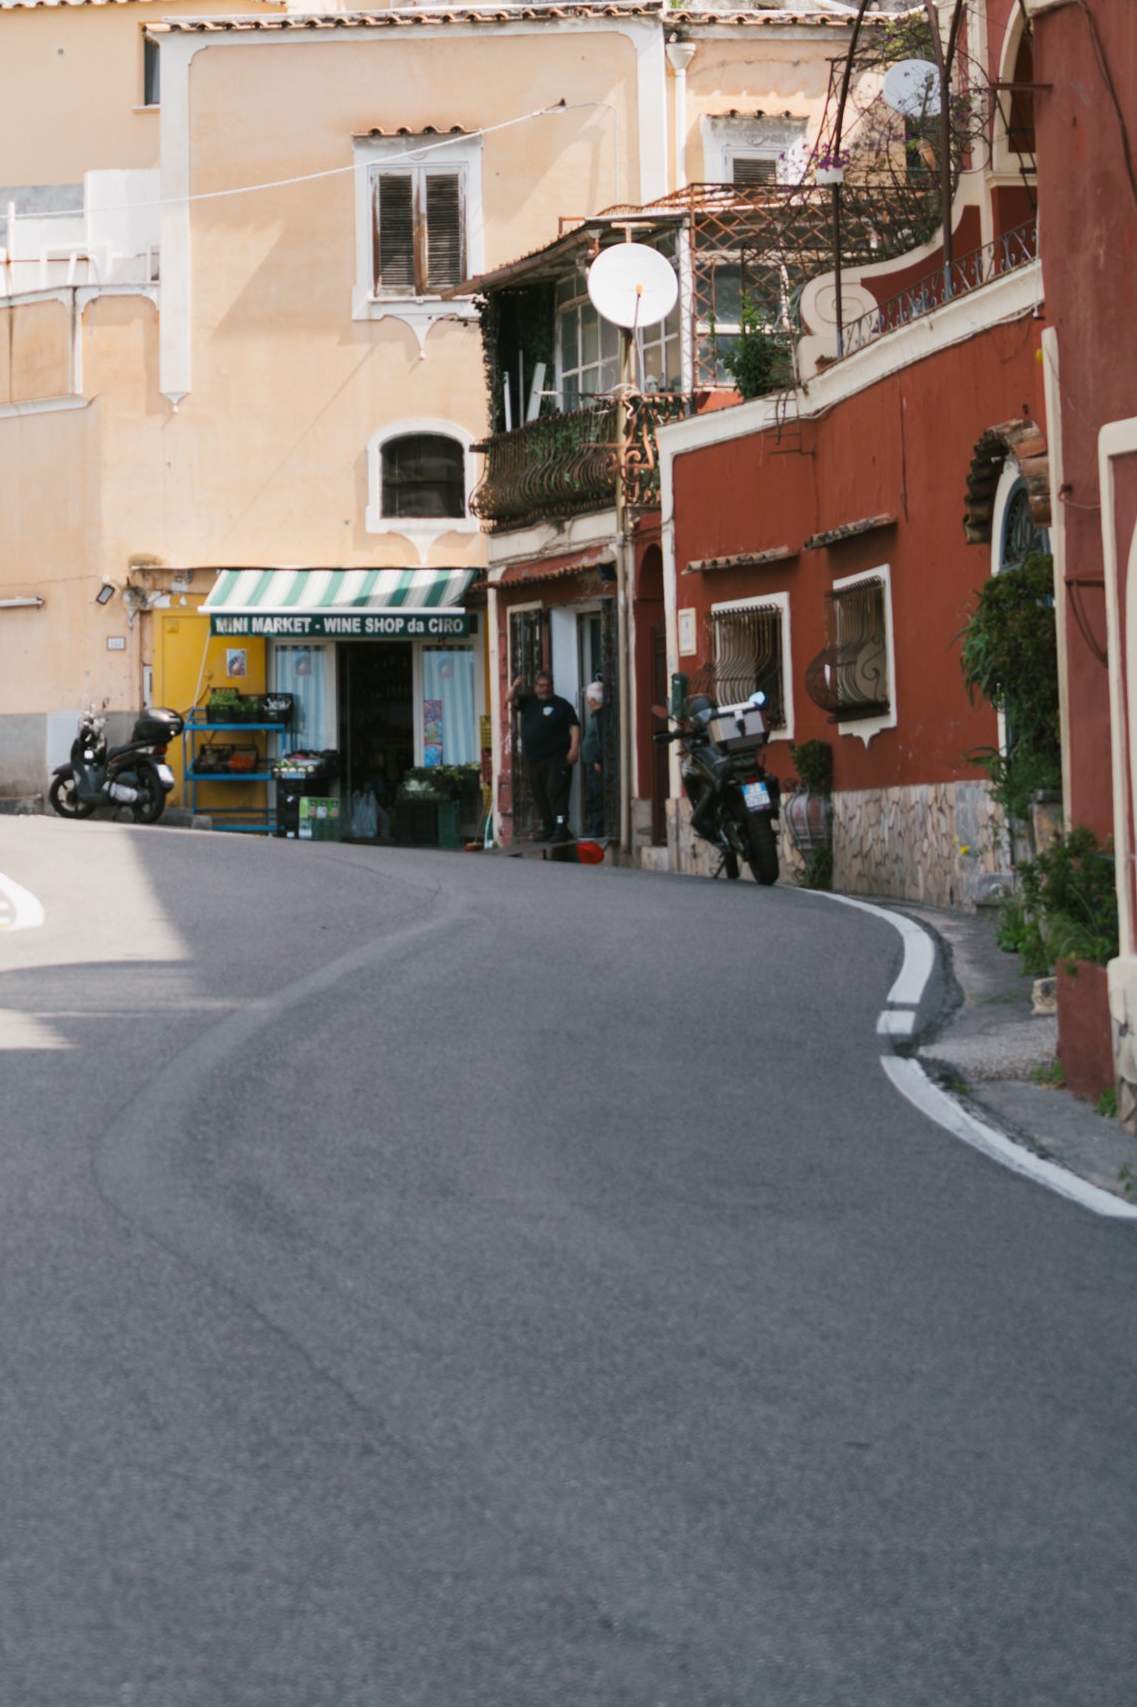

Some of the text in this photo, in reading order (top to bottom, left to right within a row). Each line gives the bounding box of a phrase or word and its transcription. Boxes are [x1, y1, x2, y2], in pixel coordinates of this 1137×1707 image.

[216, 617, 248, 632] MINI
[251, 617, 312, 633] MARKET
[323, 617, 361, 632] WINE
[365, 617, 404, 633] SHOP
[407, 617, 424, 633] da
[428, 617, 464, 633] CIRO
